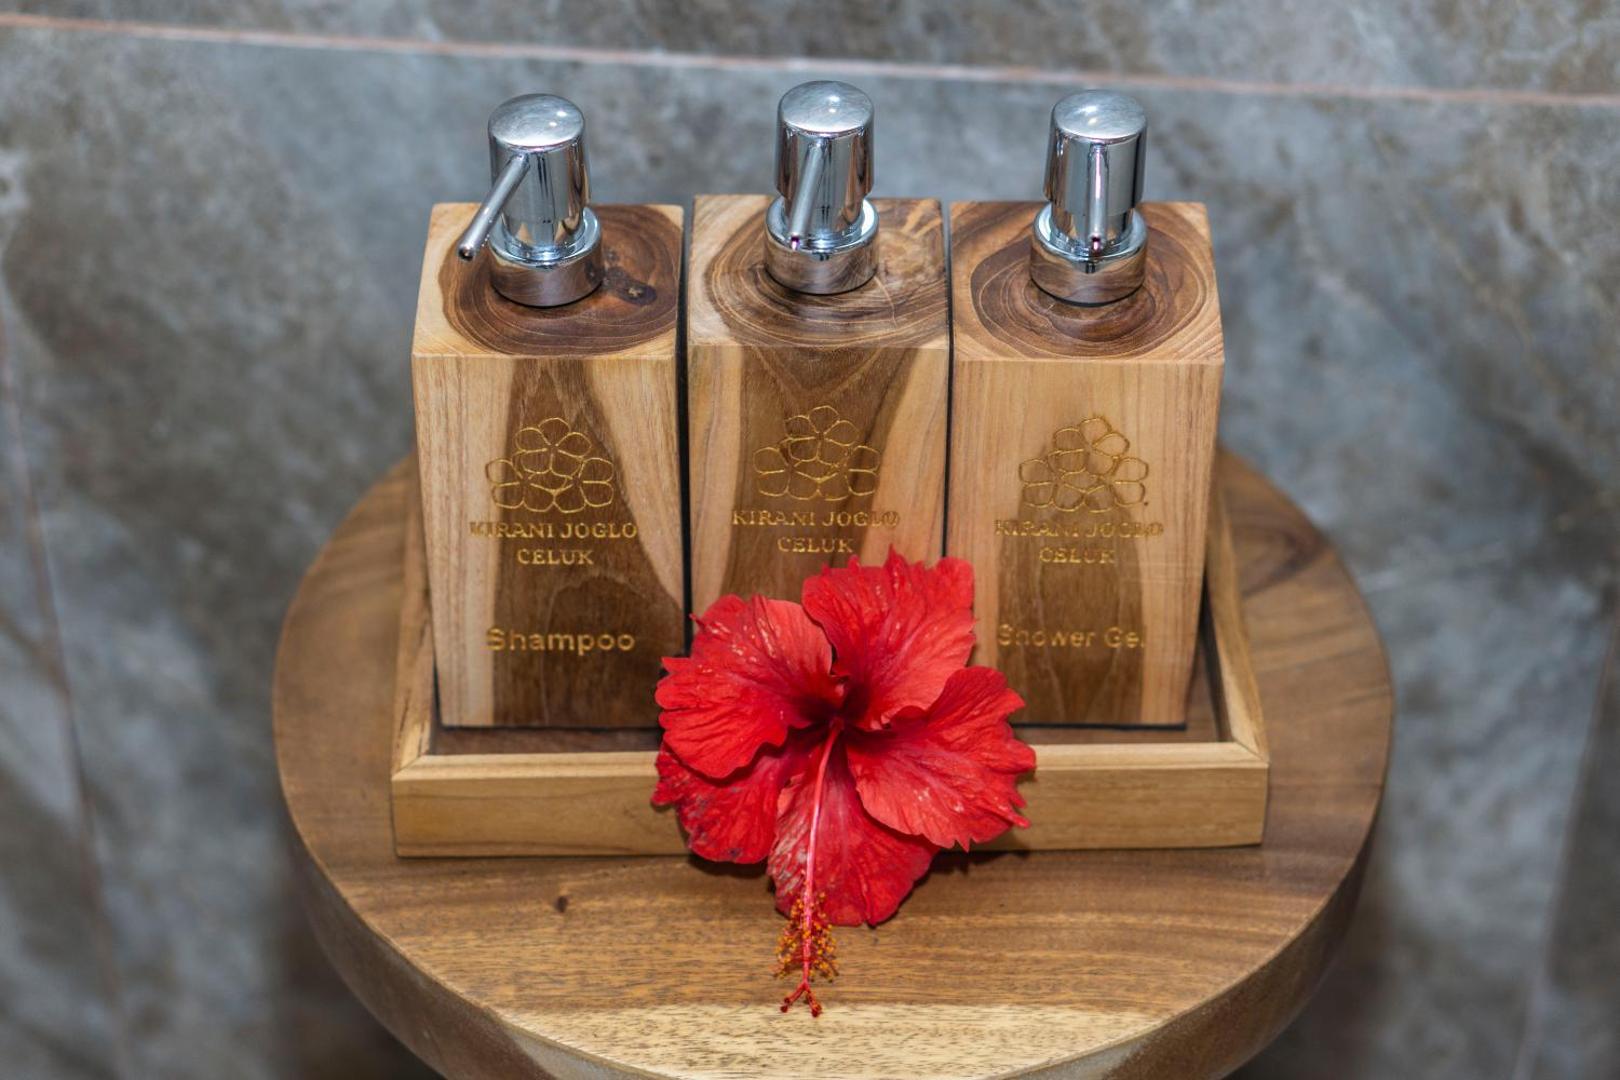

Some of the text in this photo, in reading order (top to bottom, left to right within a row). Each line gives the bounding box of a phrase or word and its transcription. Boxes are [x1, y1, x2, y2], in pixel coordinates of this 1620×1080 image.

[732, 510, 899, 529] KIRANI JOGLO
[470, 522, 638, 538] KIRANI JOGLO
[777, 537, 853, 553] CELUK
[517, 549, 594, 565] CELUK
[1039, 547, 1116, 564] CELUK
[487, 627, 636, 657] Shampoo
[998, 623, 1096, 648] Shower
